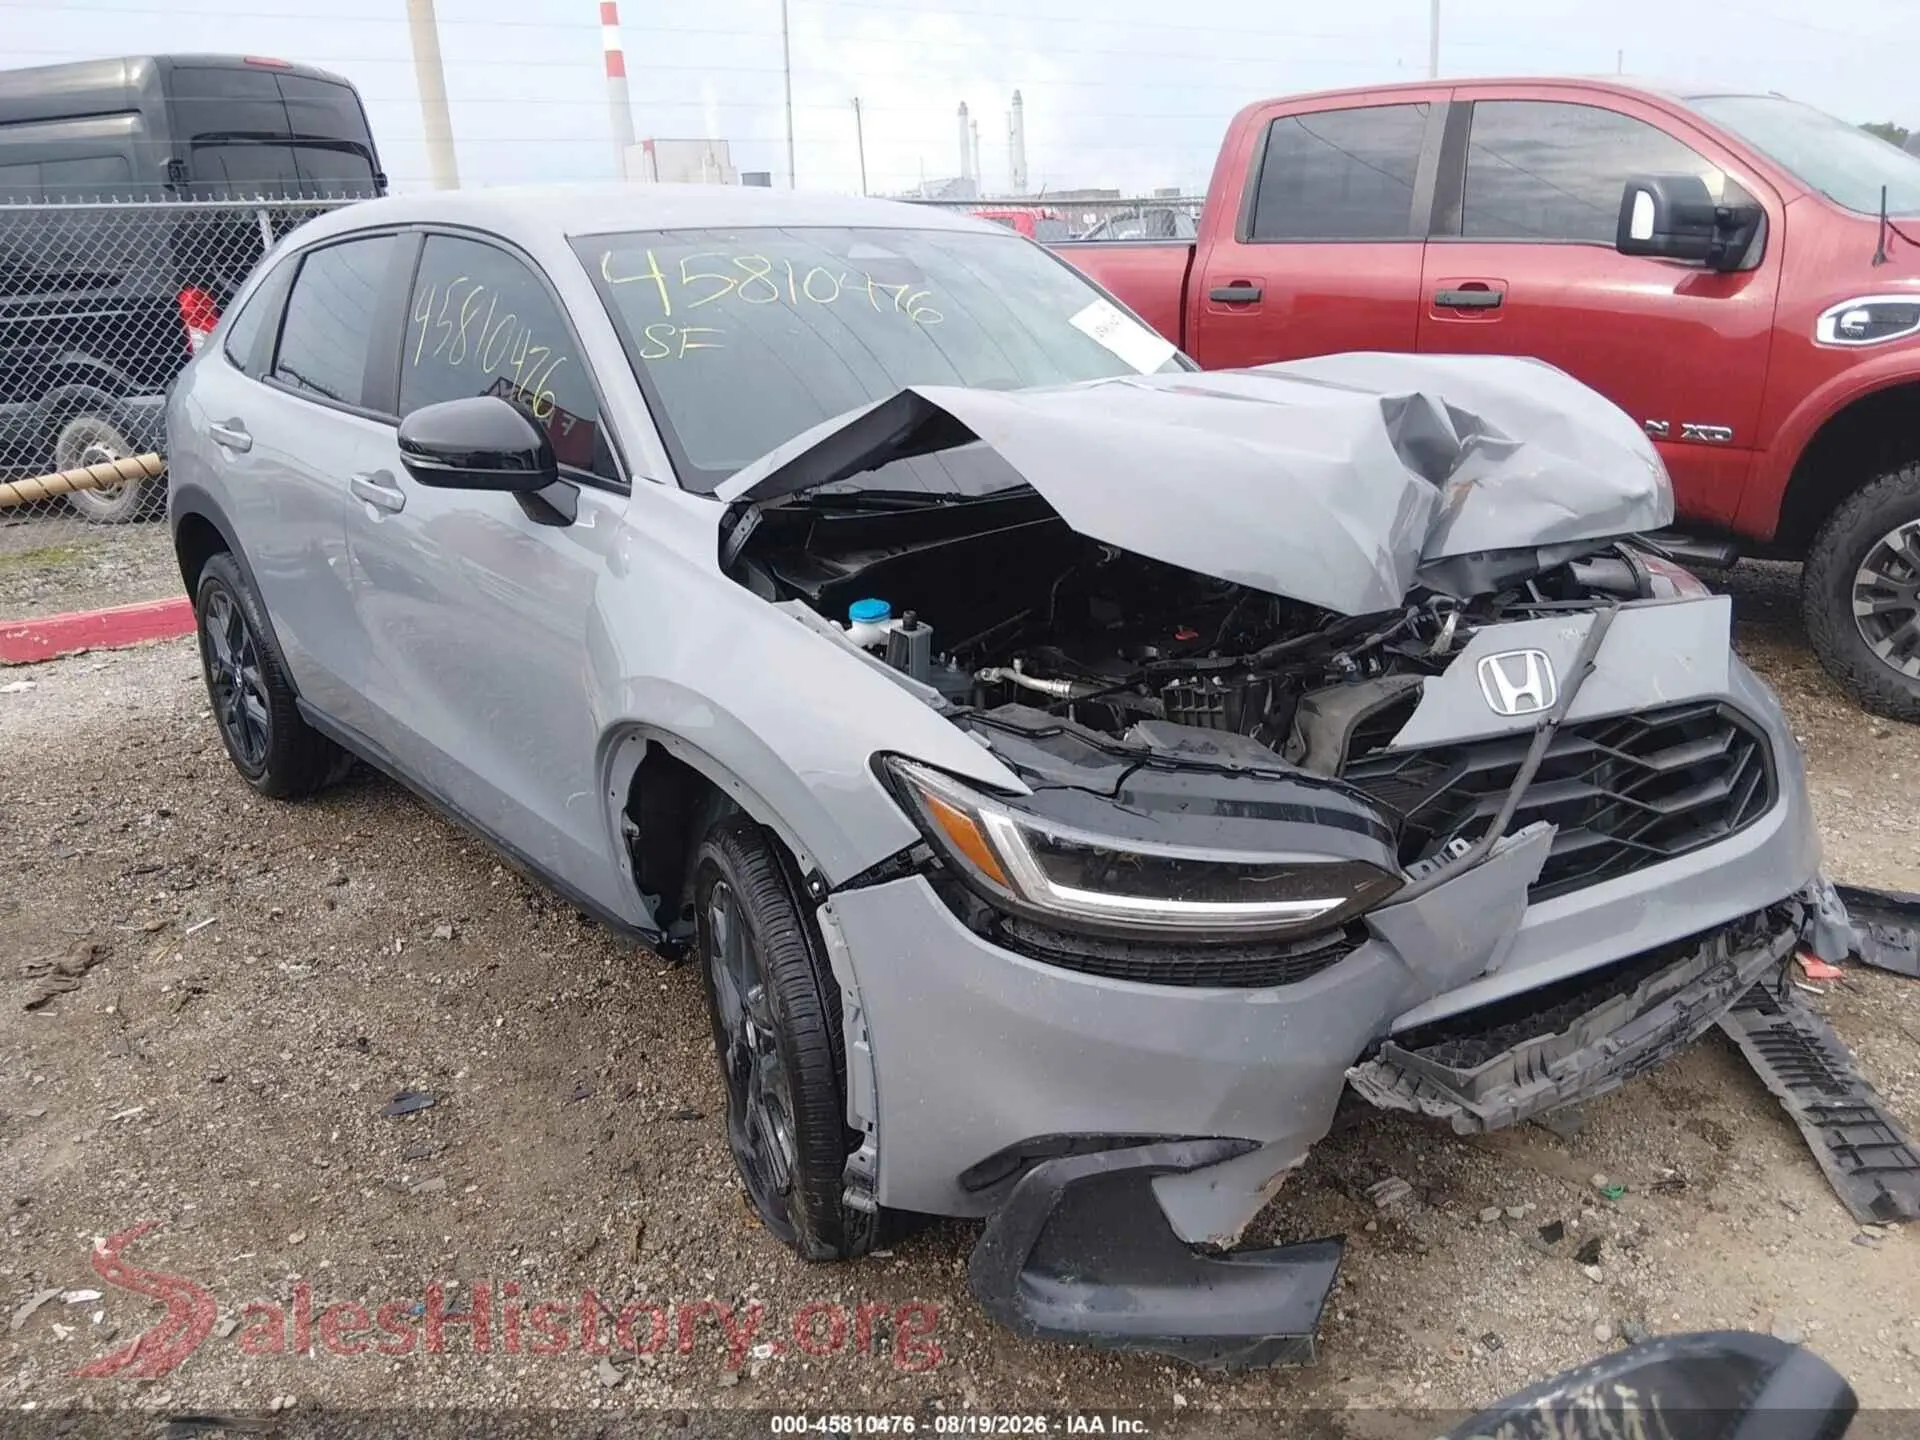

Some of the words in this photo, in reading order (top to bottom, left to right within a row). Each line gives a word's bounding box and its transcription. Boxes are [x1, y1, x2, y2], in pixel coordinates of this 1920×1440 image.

[601, 249, 944, 325] 45810476
[414, 276, 568, 418] 45810476
[640, 322, 726, 360] SF
[1681, 423, 1732, 441] XD
